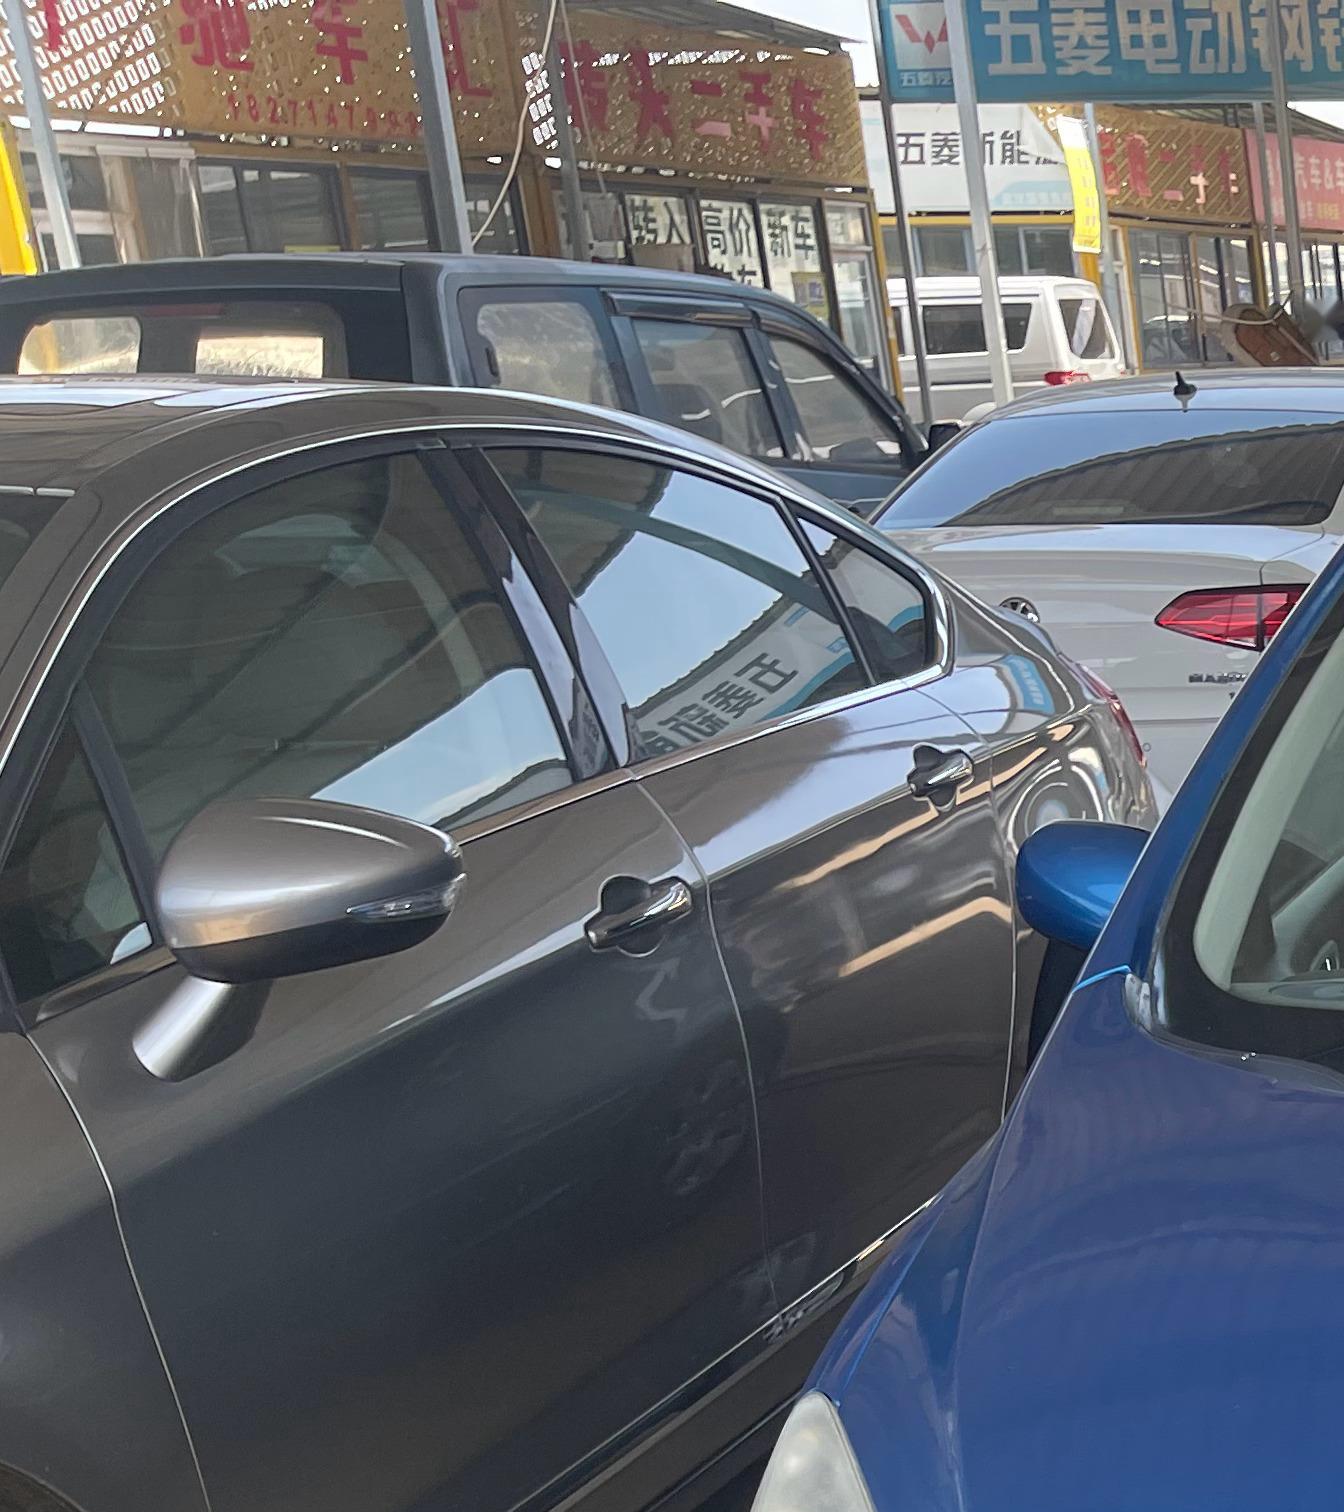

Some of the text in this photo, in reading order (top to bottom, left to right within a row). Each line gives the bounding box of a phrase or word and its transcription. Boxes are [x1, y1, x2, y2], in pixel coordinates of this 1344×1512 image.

[896, 129, 1058, 166] 五菱能
[702, 203, 751, 257] 高价
